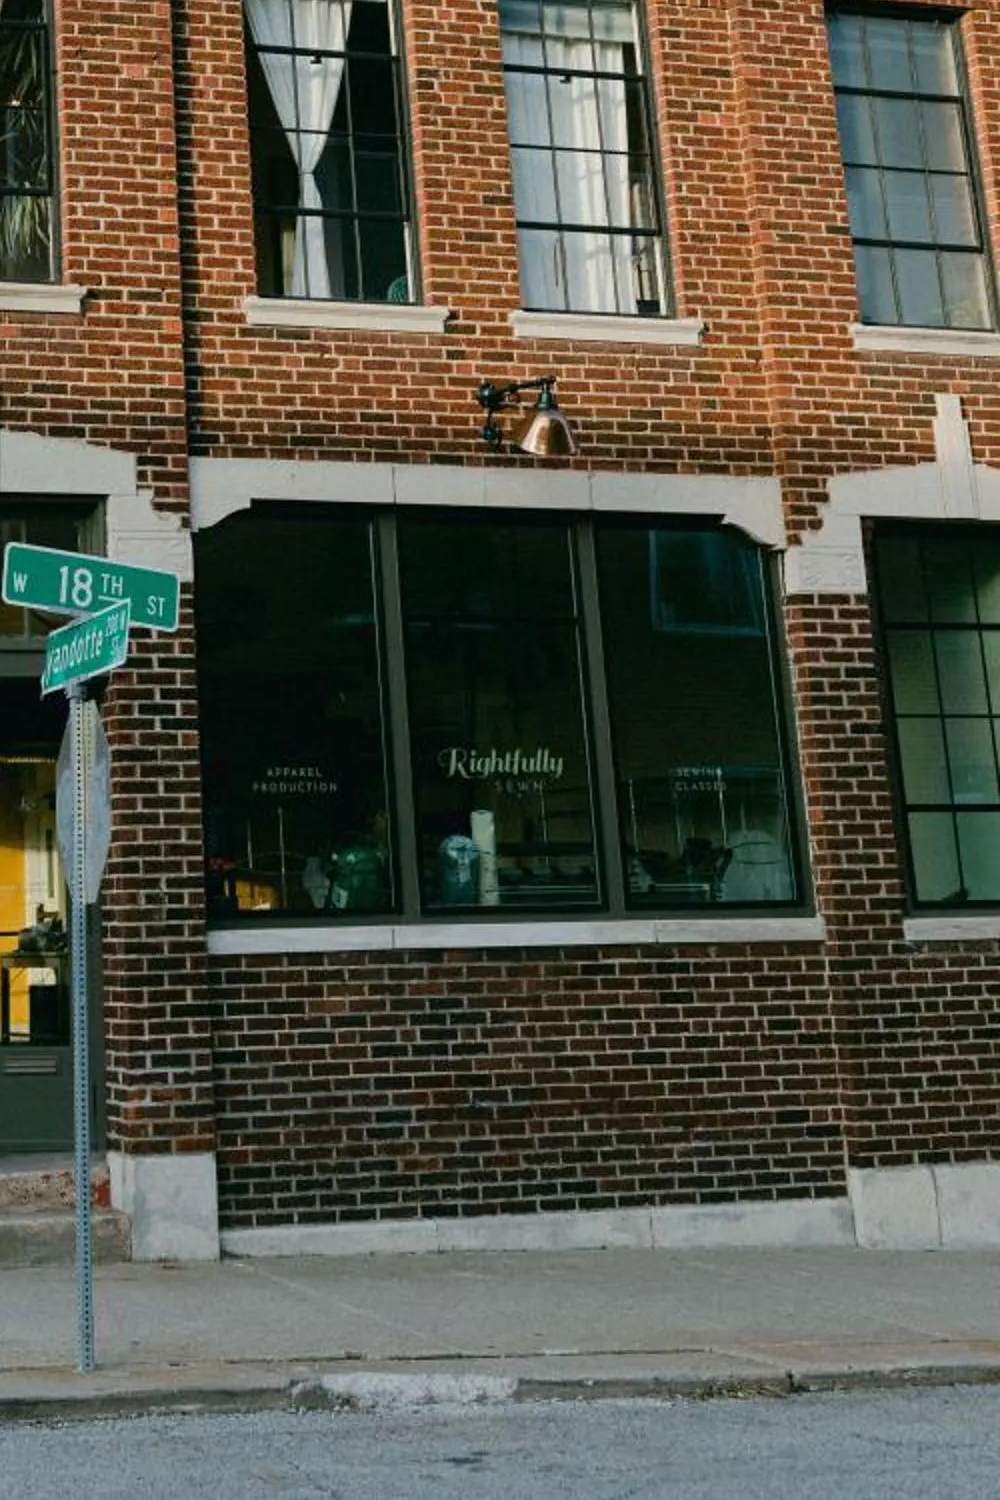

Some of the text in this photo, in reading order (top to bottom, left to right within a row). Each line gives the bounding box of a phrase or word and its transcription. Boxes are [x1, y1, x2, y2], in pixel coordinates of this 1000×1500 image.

[13, 571, 28, 593] W
[147, 595, 165, 618] ST
[266, 767, 323, 778] APPAREL
[437, 747, 564, 779] Rightfully
[252, 781, 337, 793] PRODUCTION
